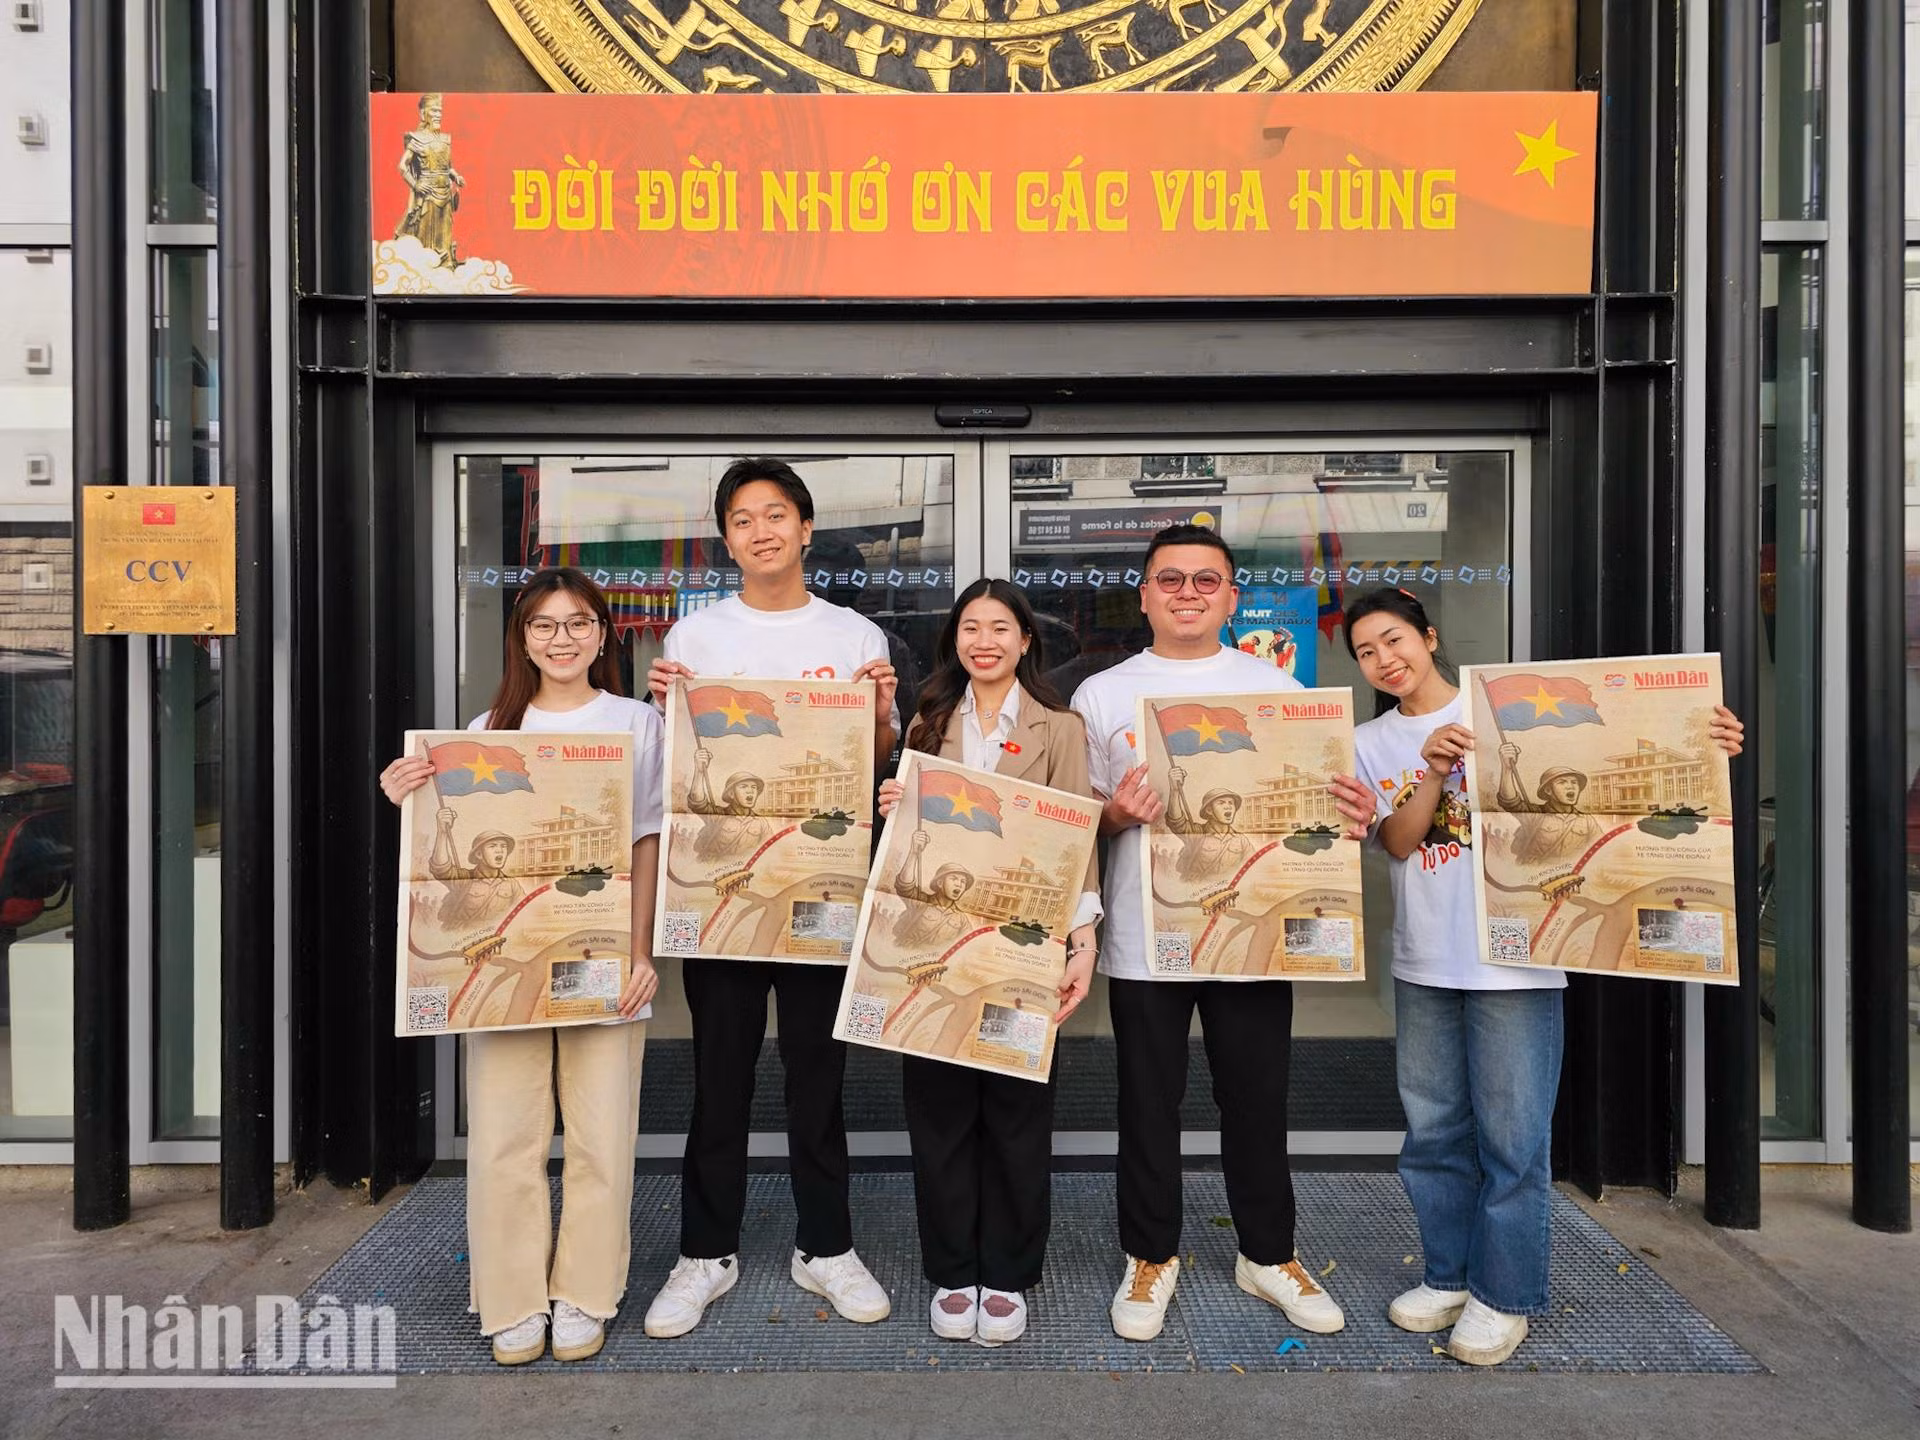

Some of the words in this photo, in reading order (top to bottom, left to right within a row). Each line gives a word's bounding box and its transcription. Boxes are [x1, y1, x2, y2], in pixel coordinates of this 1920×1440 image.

[511, 155, 613, 231] ĐỜI
[635, 156, 737, 231] ĐỜI
[761, 155, 890, 231] NHỚ
[911, 161, 992, 233] ƠN
[1017, 155, 1129, 231] CÁC
[1151, 169, 1269, 231] VUA
[1291, 155, 1457, 231] HÙNG
[126, 560, 192, 582] CCV
[1242, 609, 1272, 618] NUIT
[1634, 672, 1675, 686] Nhân
[1677, 670, 1708, 685] Dân
[809, 692, 840, 704] Nhân
[842, 692, 865, 705] Dân
[1282, 704, 1316, 717] Nhân
[1318, 704, 1343, 716] Dân
[563, 744, 595, 758] Nhân
[598, 744, 623, 758] Dân
[1036, 800, 1068, 819] Nhân
[1066, 808, 1091, 826] Dân
[1438, 843, 1460, 864] DO
